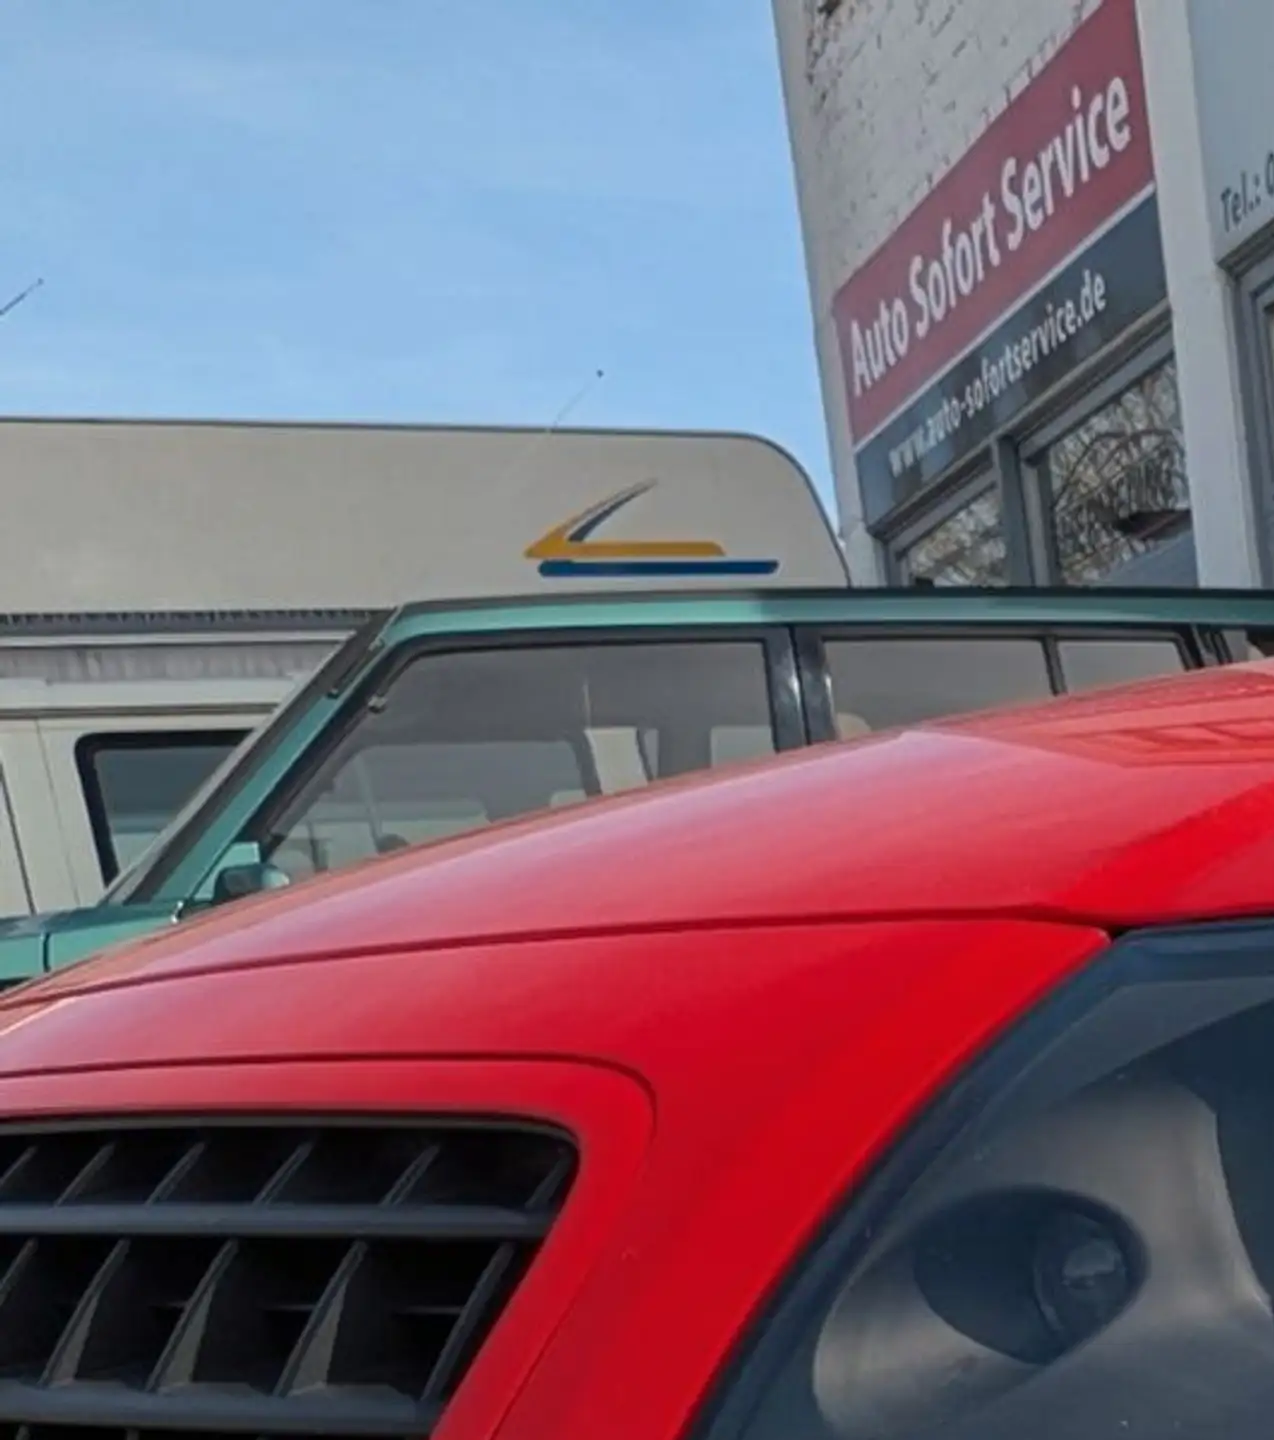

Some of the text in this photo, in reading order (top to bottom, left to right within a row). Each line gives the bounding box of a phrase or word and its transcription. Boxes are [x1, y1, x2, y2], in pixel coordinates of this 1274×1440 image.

[850, 76, 1132, 398] Auto Sofort Service
[1220, 170, 1262, 233] Tel.:
[888, 269, 1107, 478] www.auto-sofortservice.de
